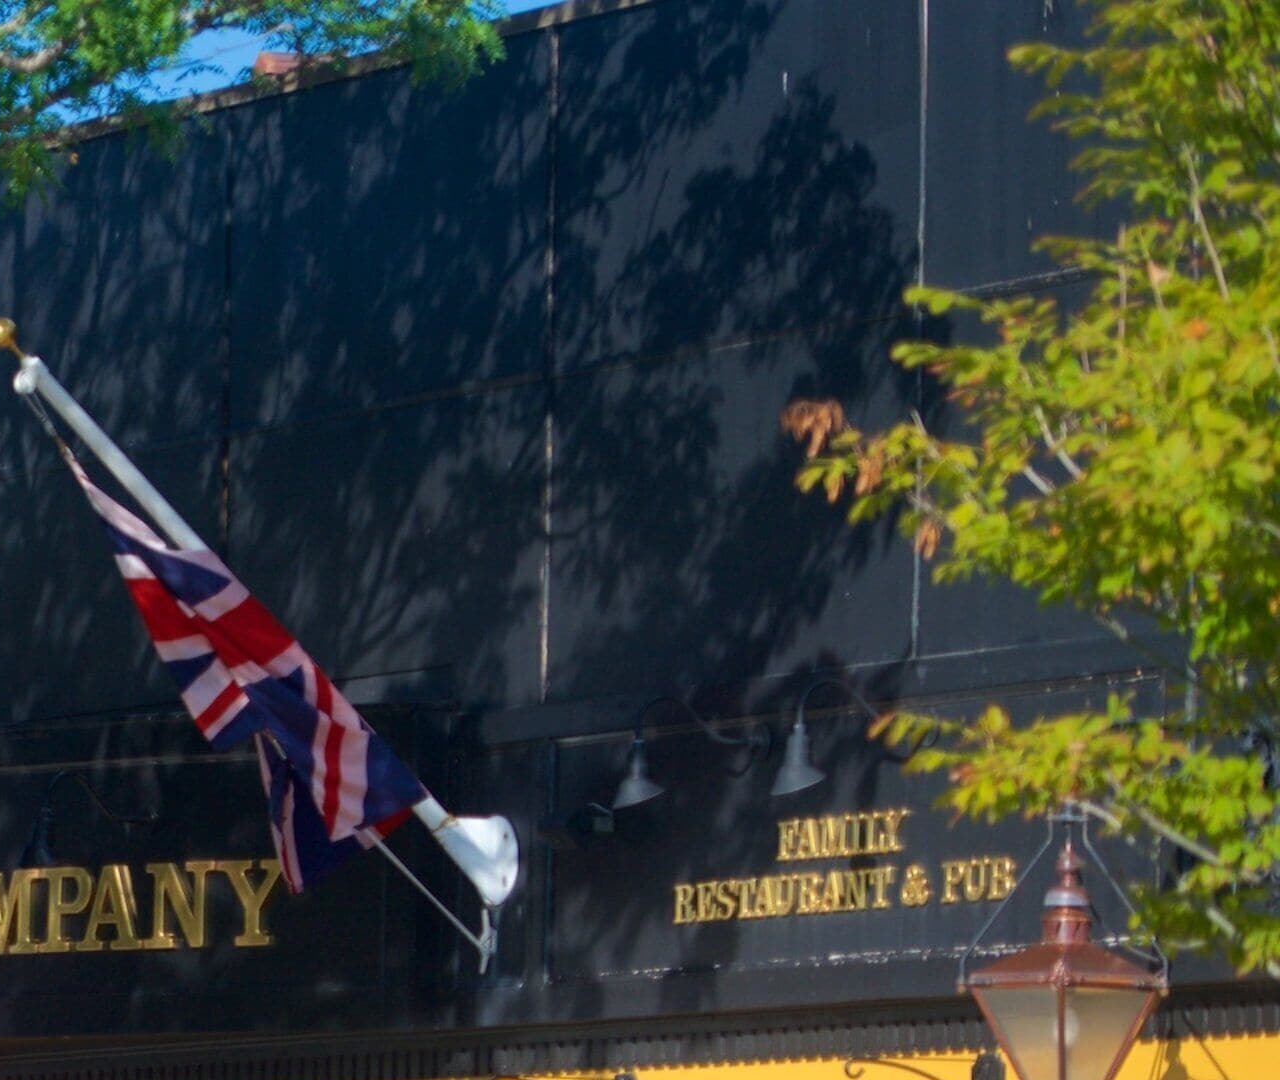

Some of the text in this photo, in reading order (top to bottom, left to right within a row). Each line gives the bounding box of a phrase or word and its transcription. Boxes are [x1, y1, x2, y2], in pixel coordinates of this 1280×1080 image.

[776, 808, 909, 861] FAMILY
[673, 856, 1017, 924] RESTAURANT & PUB
